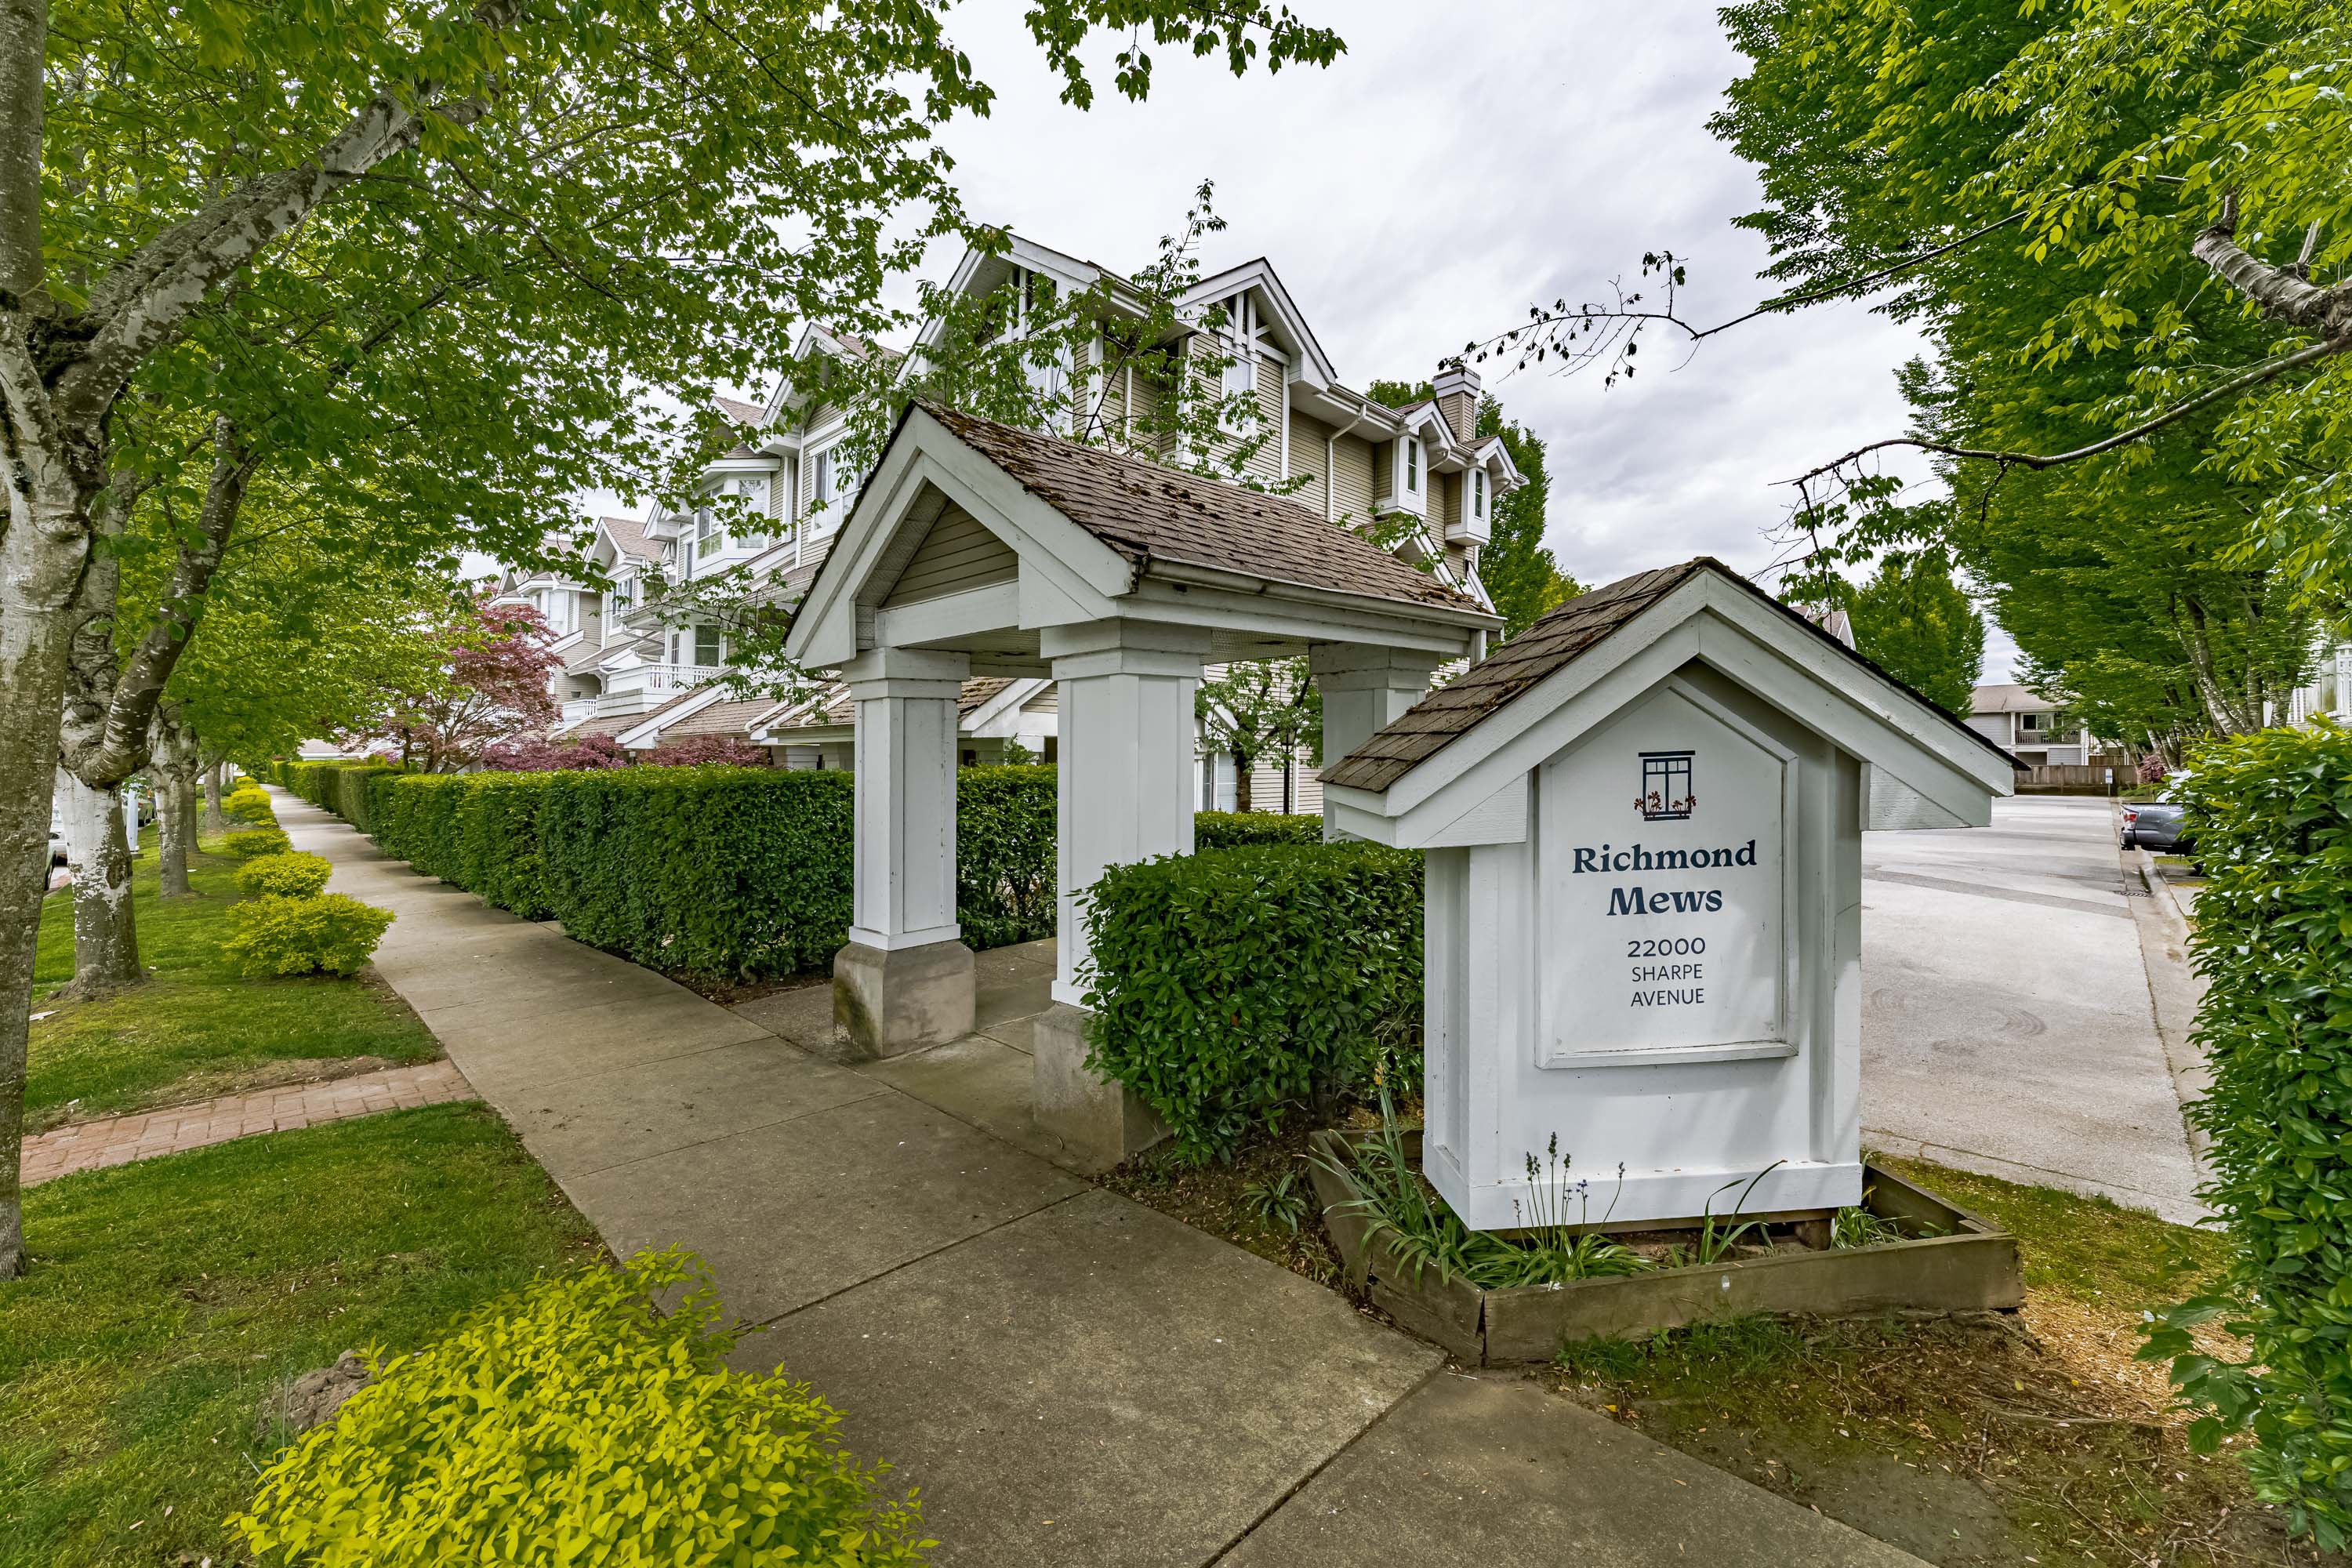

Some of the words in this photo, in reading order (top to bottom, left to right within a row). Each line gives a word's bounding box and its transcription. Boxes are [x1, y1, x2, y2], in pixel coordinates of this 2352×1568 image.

[1572, 839, 1757, 873] Richmond
[1606, 887, 1722, 916] Mews
[1628, 937, 1706, 958] 22000
[1632, 964, 1703, 982] SHARPE
[1631, 988, 1704, 1007] AVENUE
